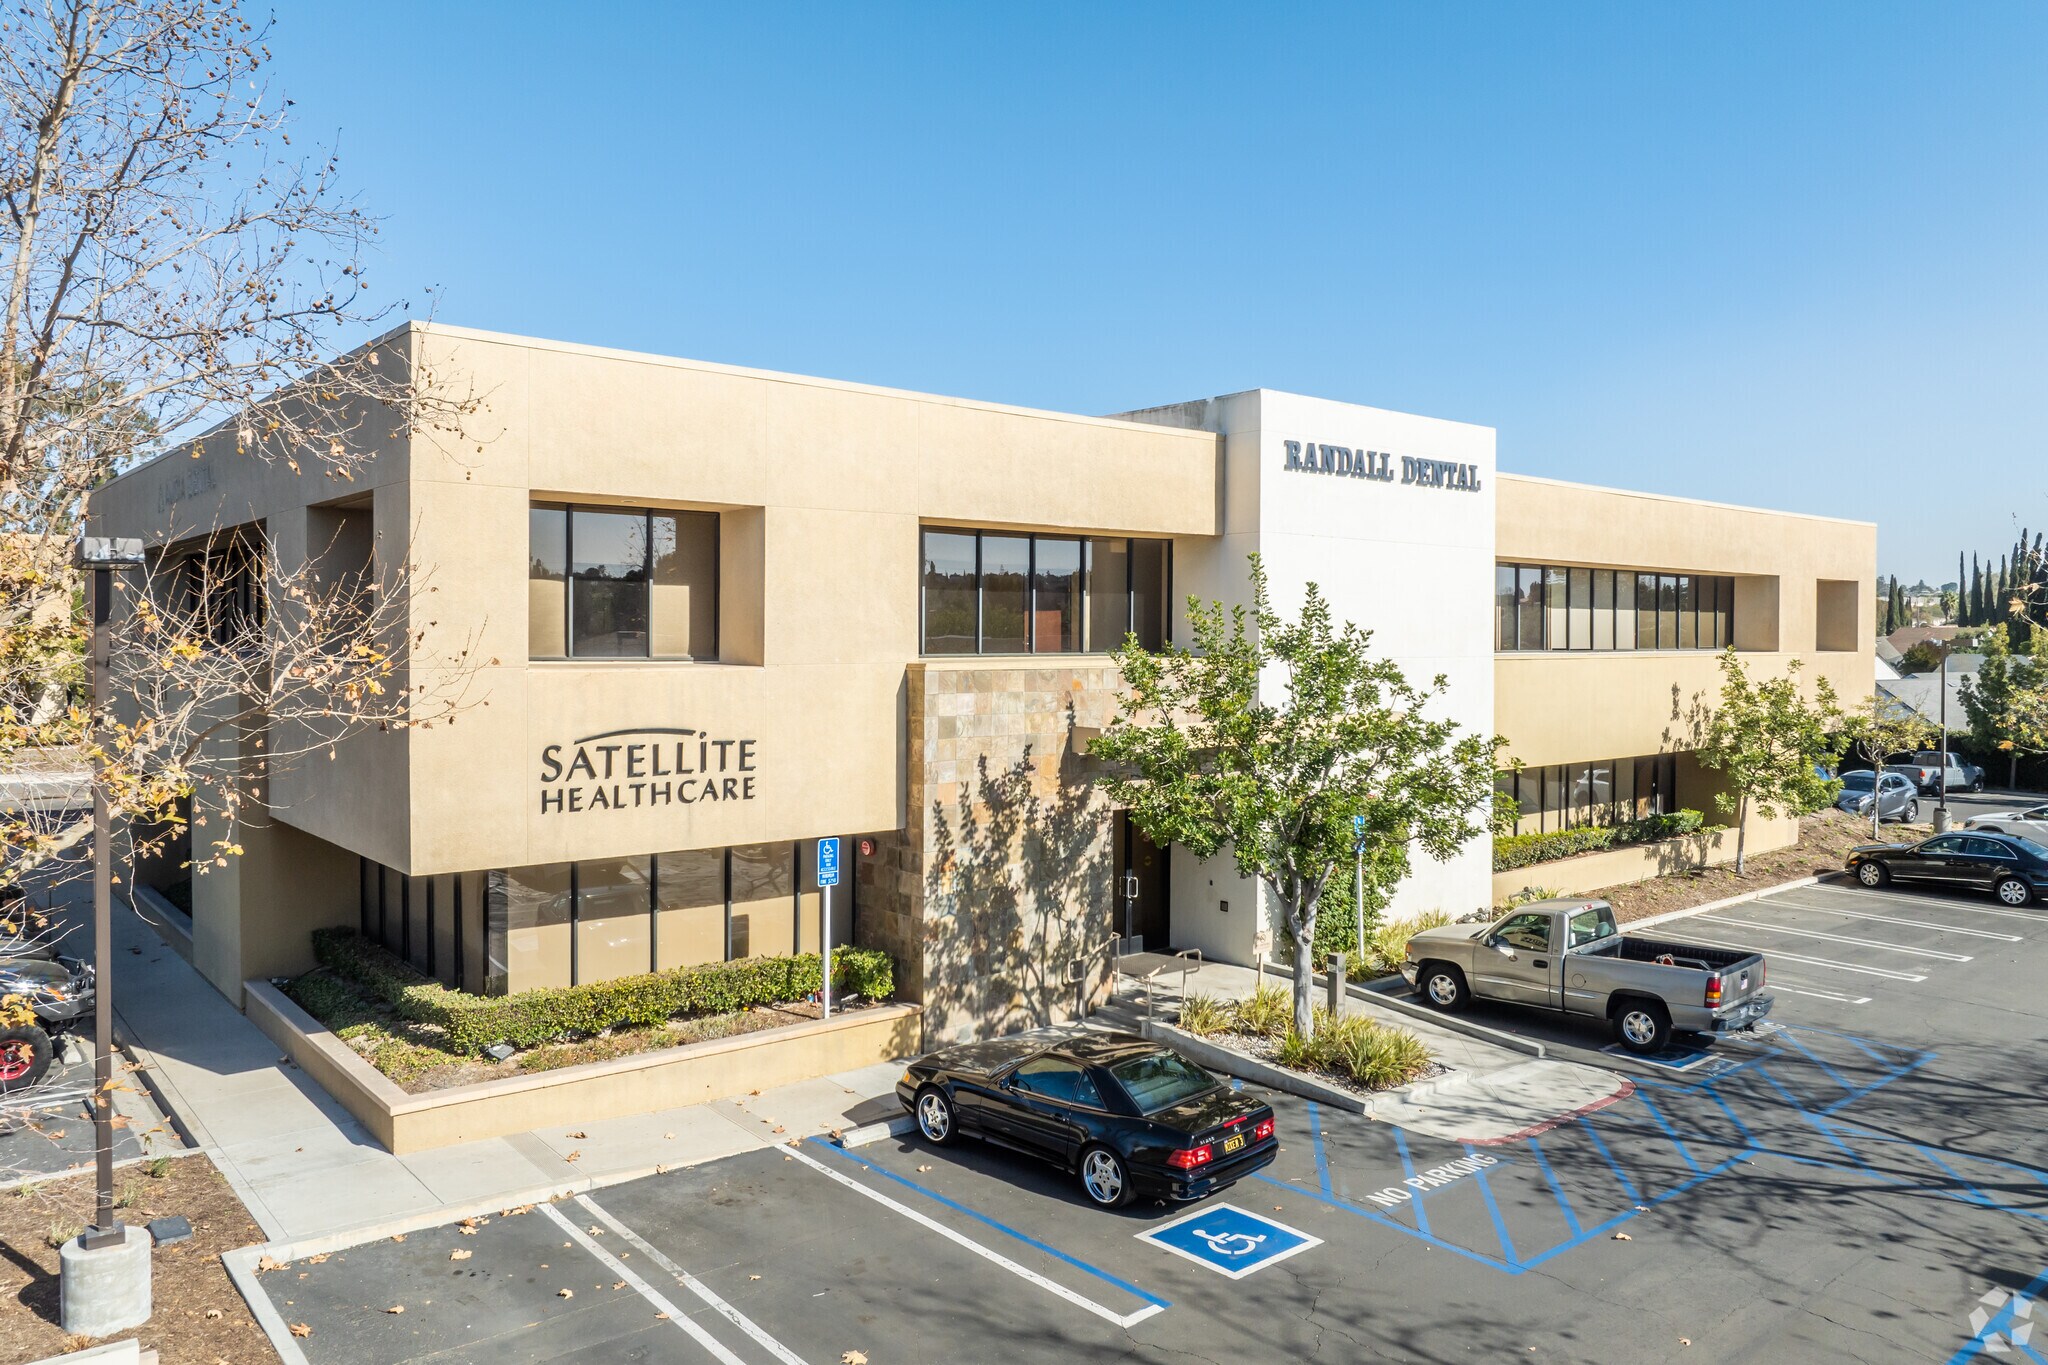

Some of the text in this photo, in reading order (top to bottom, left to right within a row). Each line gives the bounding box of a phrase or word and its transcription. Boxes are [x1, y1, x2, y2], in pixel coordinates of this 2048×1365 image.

[1284, 440, 1481, 492] RANDALL DENTAL
[541, 777, 755, 814] HEALTHCARE
[1366, 1153, 1498, 1207] NO PARKING
